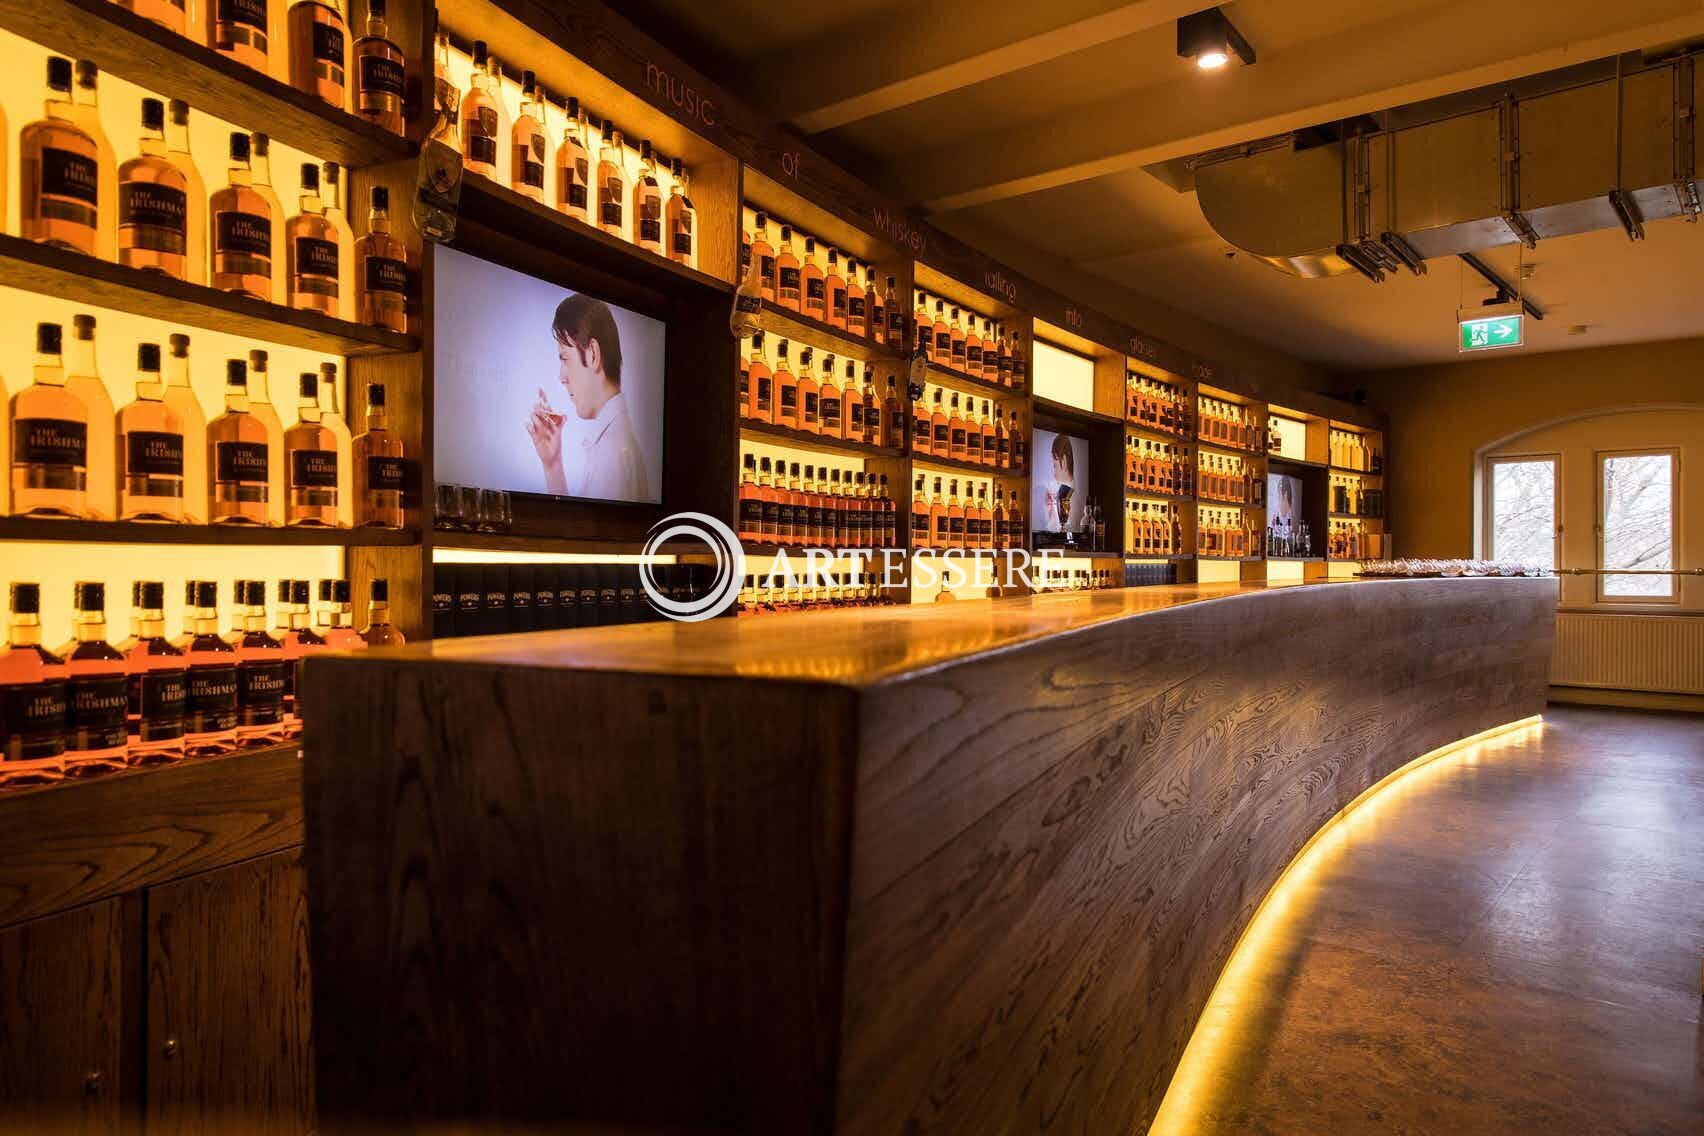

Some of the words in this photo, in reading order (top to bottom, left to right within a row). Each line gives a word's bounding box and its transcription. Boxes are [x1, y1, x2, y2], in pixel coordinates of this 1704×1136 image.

[645, 62, 715, 126] music
[782, 152, 800, 180] of
[873, 207, 927, 258] whiskey
